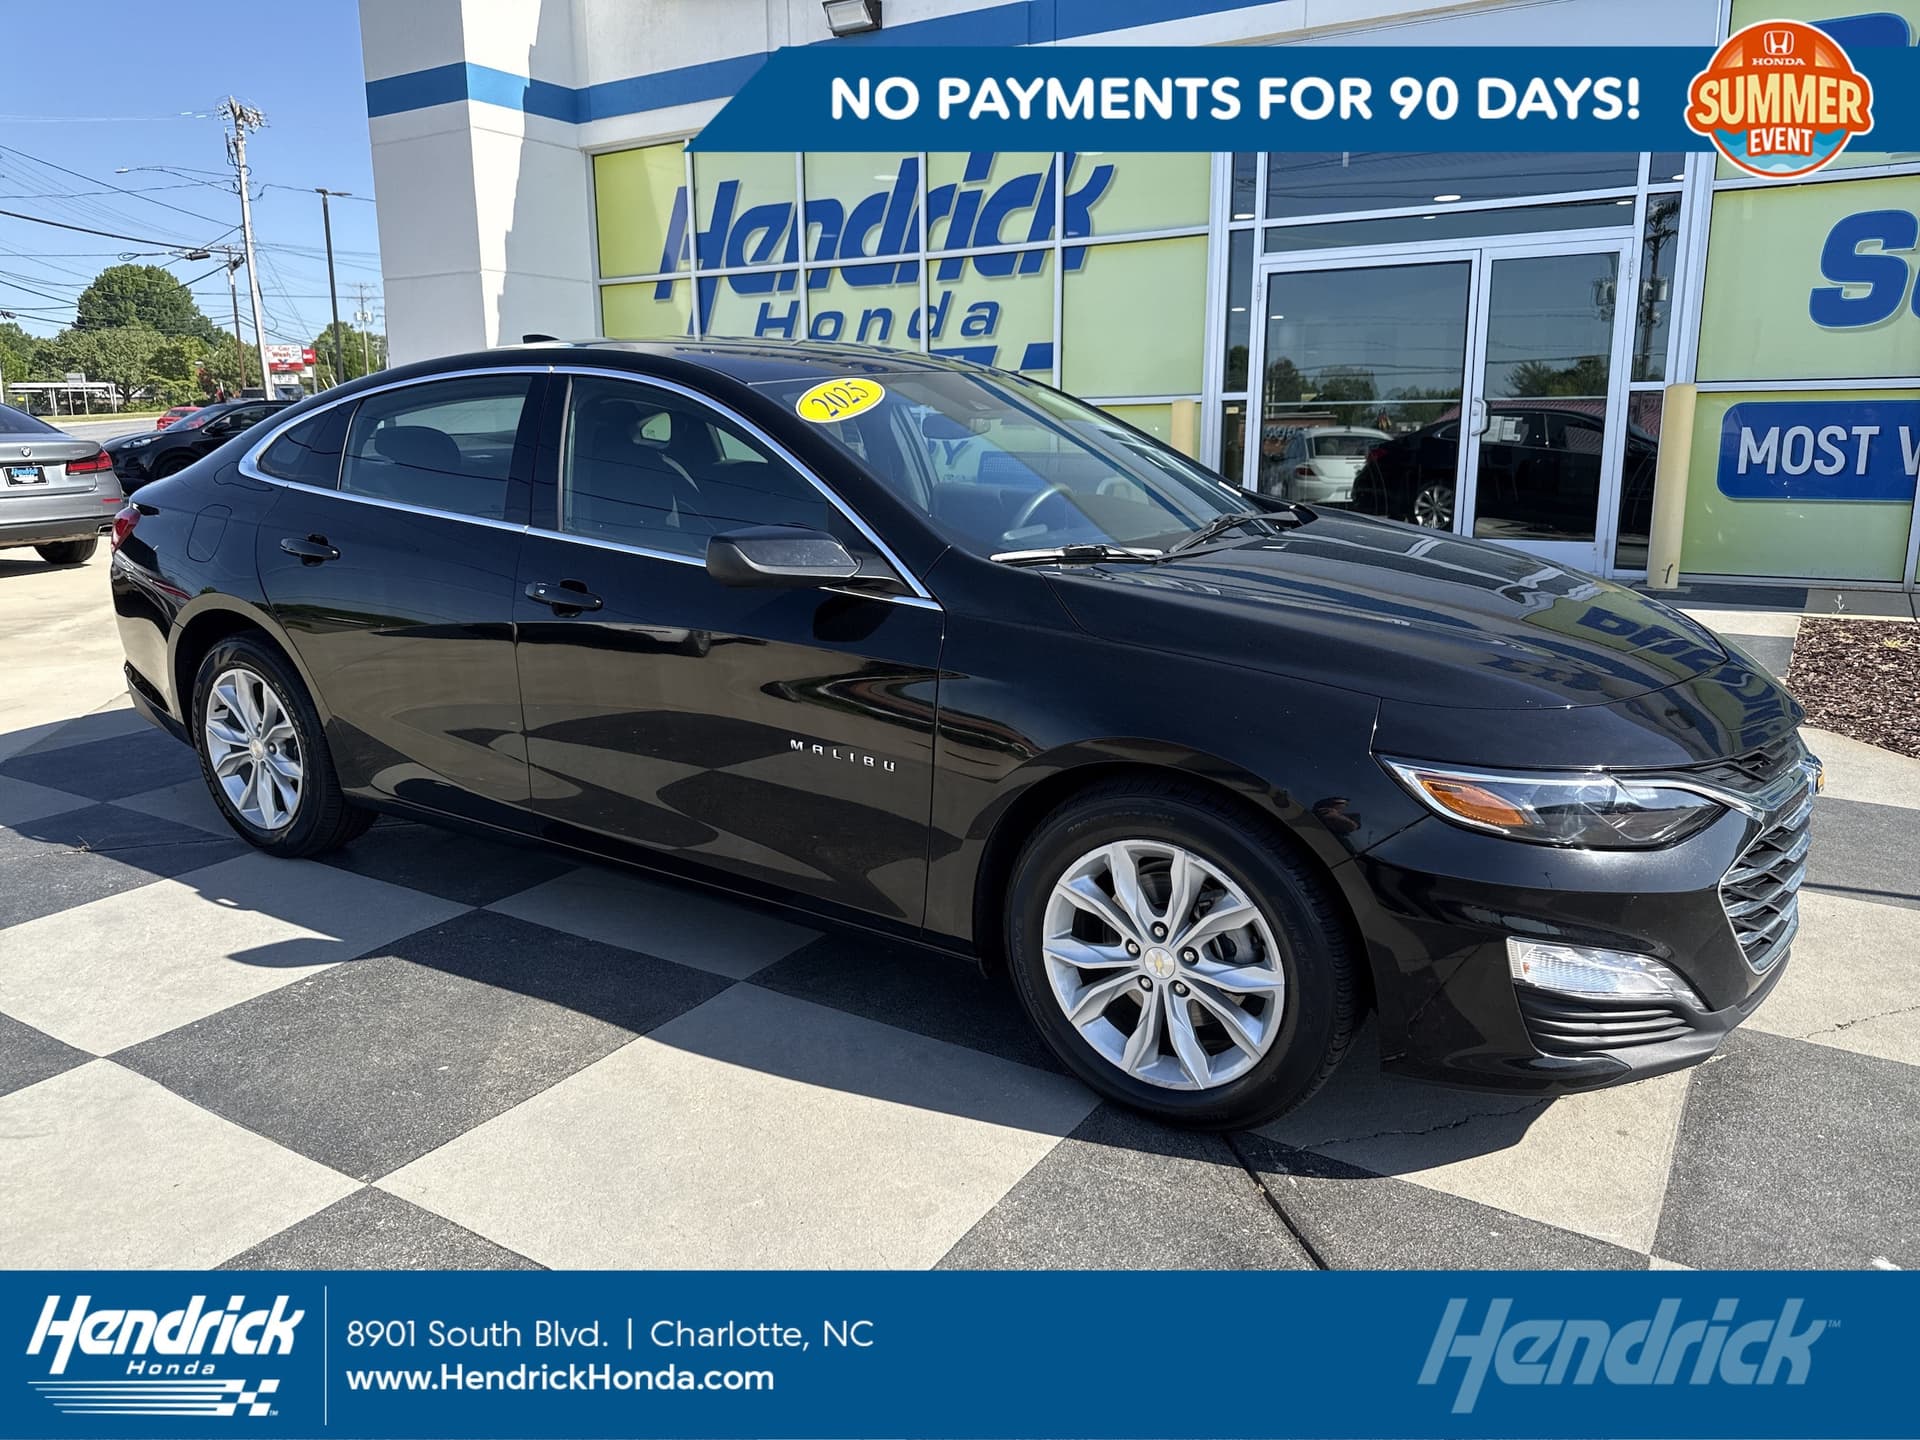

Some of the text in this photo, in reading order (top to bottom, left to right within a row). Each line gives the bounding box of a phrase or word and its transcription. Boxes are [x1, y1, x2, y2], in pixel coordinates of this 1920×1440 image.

[654, 151, 1115, 336] Hendrick
[753, 291, 1000, 342] Honda
[811, 382, 869, 417] 2025
[1737, 425, 1880, 476] MOST
[790, 739, 896, 773] MALIBU
